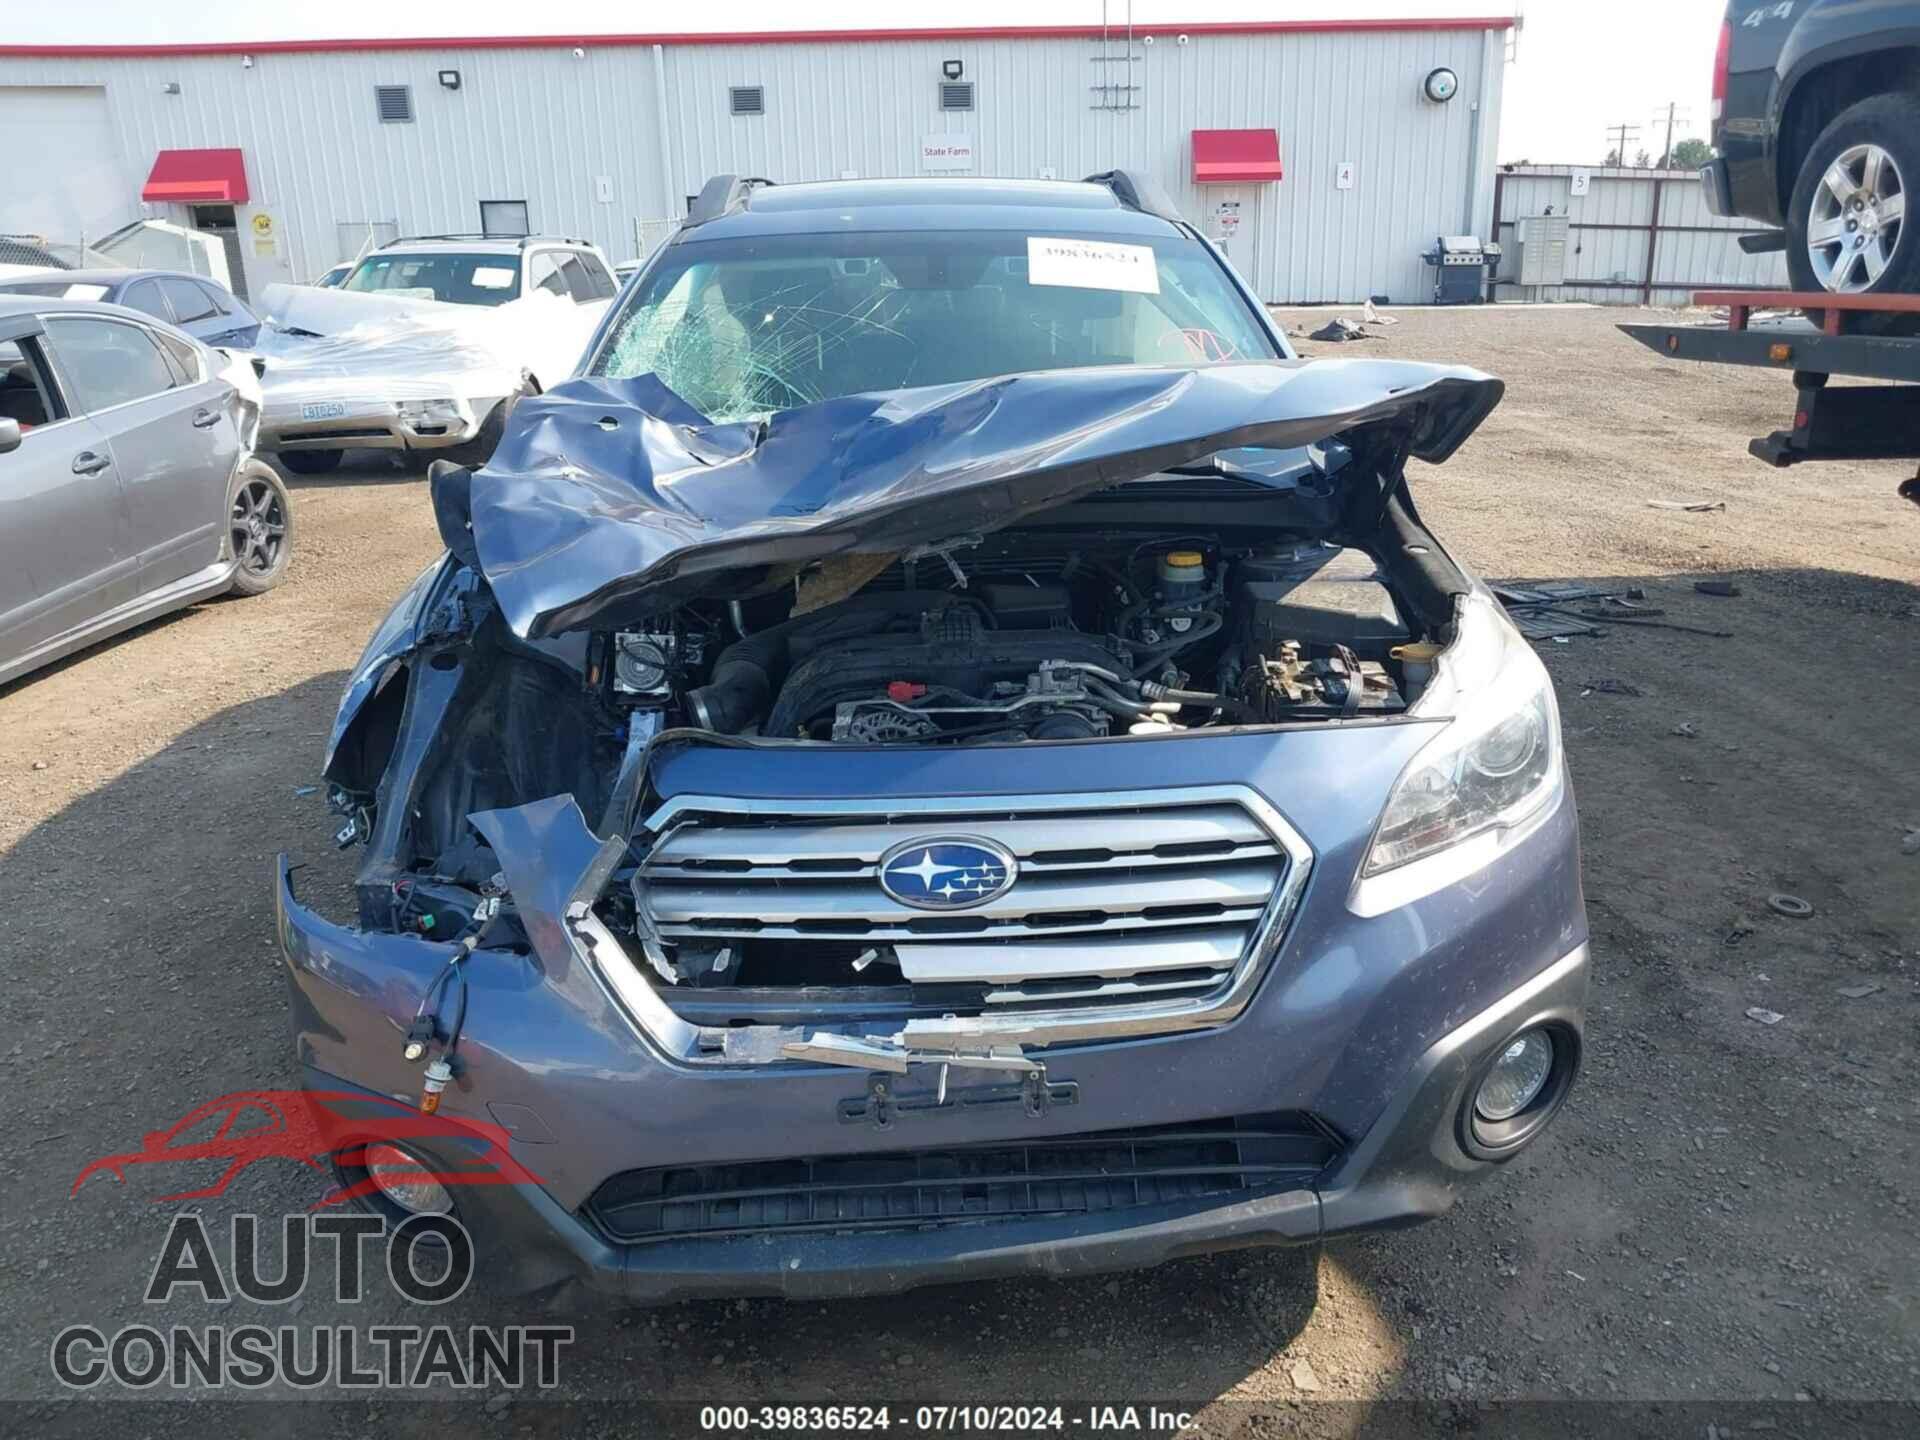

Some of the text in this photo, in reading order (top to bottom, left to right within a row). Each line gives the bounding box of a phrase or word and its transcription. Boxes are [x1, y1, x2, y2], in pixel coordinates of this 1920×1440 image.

[924, 147, 970, 156] State Farm
[1341, 169, 1349, 182] 4
[1577, 175, 1585, 188] 5
